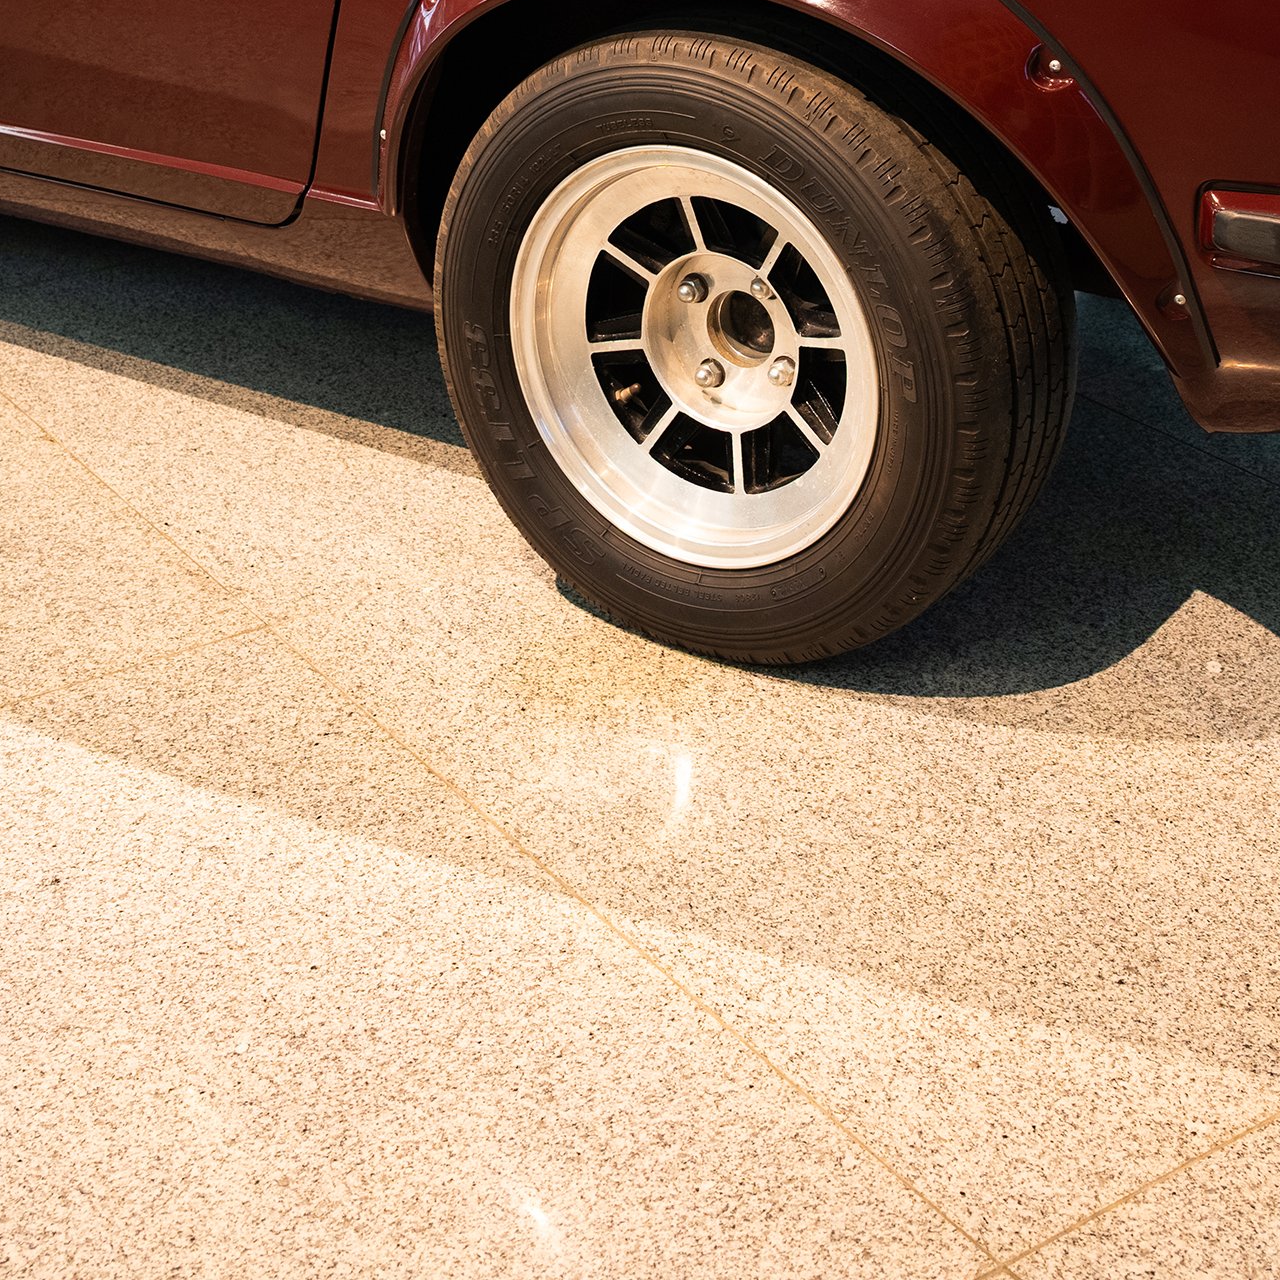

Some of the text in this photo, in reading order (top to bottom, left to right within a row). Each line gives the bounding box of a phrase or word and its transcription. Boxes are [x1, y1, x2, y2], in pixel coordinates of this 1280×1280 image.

[758, 143, 918, 403] DUNLOP
[462, 320, 606, 566] SP LT33
